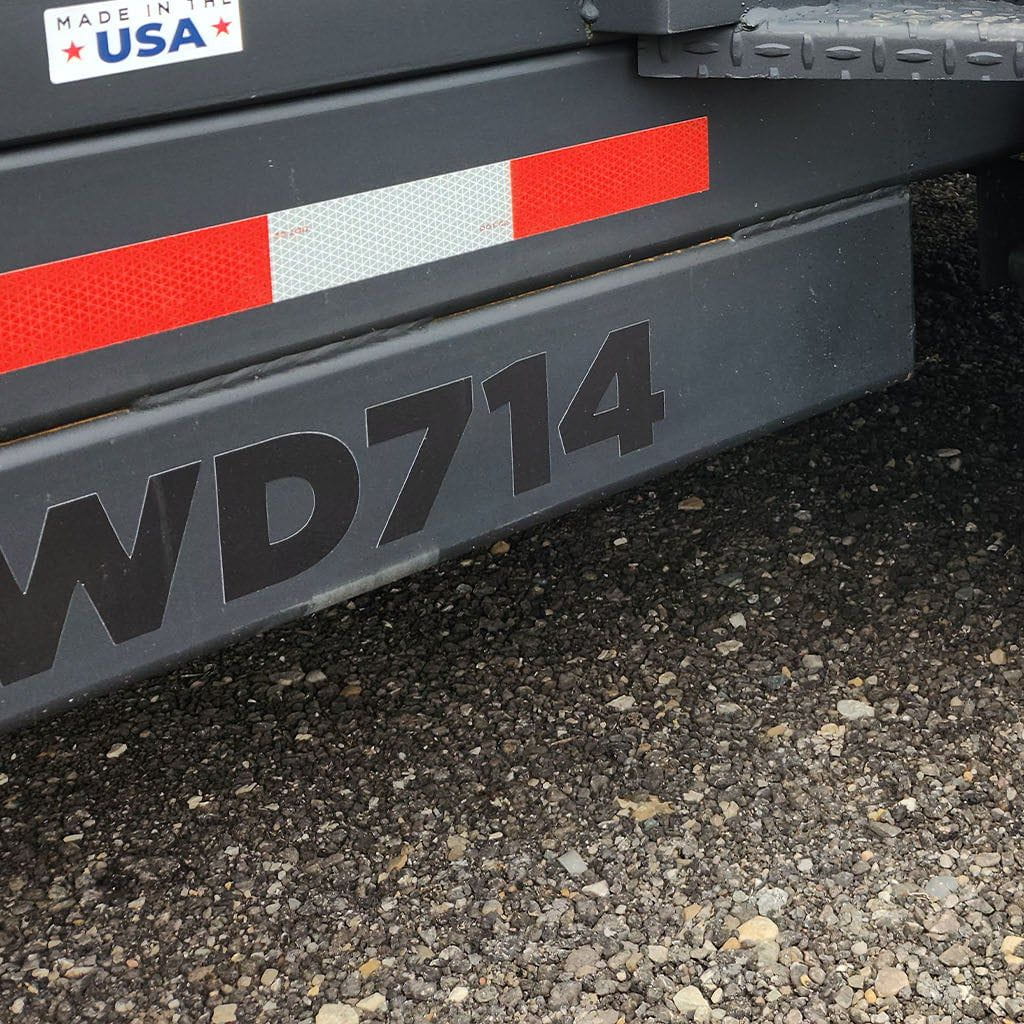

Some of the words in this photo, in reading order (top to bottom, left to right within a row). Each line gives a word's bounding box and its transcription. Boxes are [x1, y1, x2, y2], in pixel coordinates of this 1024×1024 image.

[57, 6, 129, 31] MADE
[147, 0, 170, 18] IN
[96, 17, 207, 64] USA
[0, 319, 665, 687] WD714
